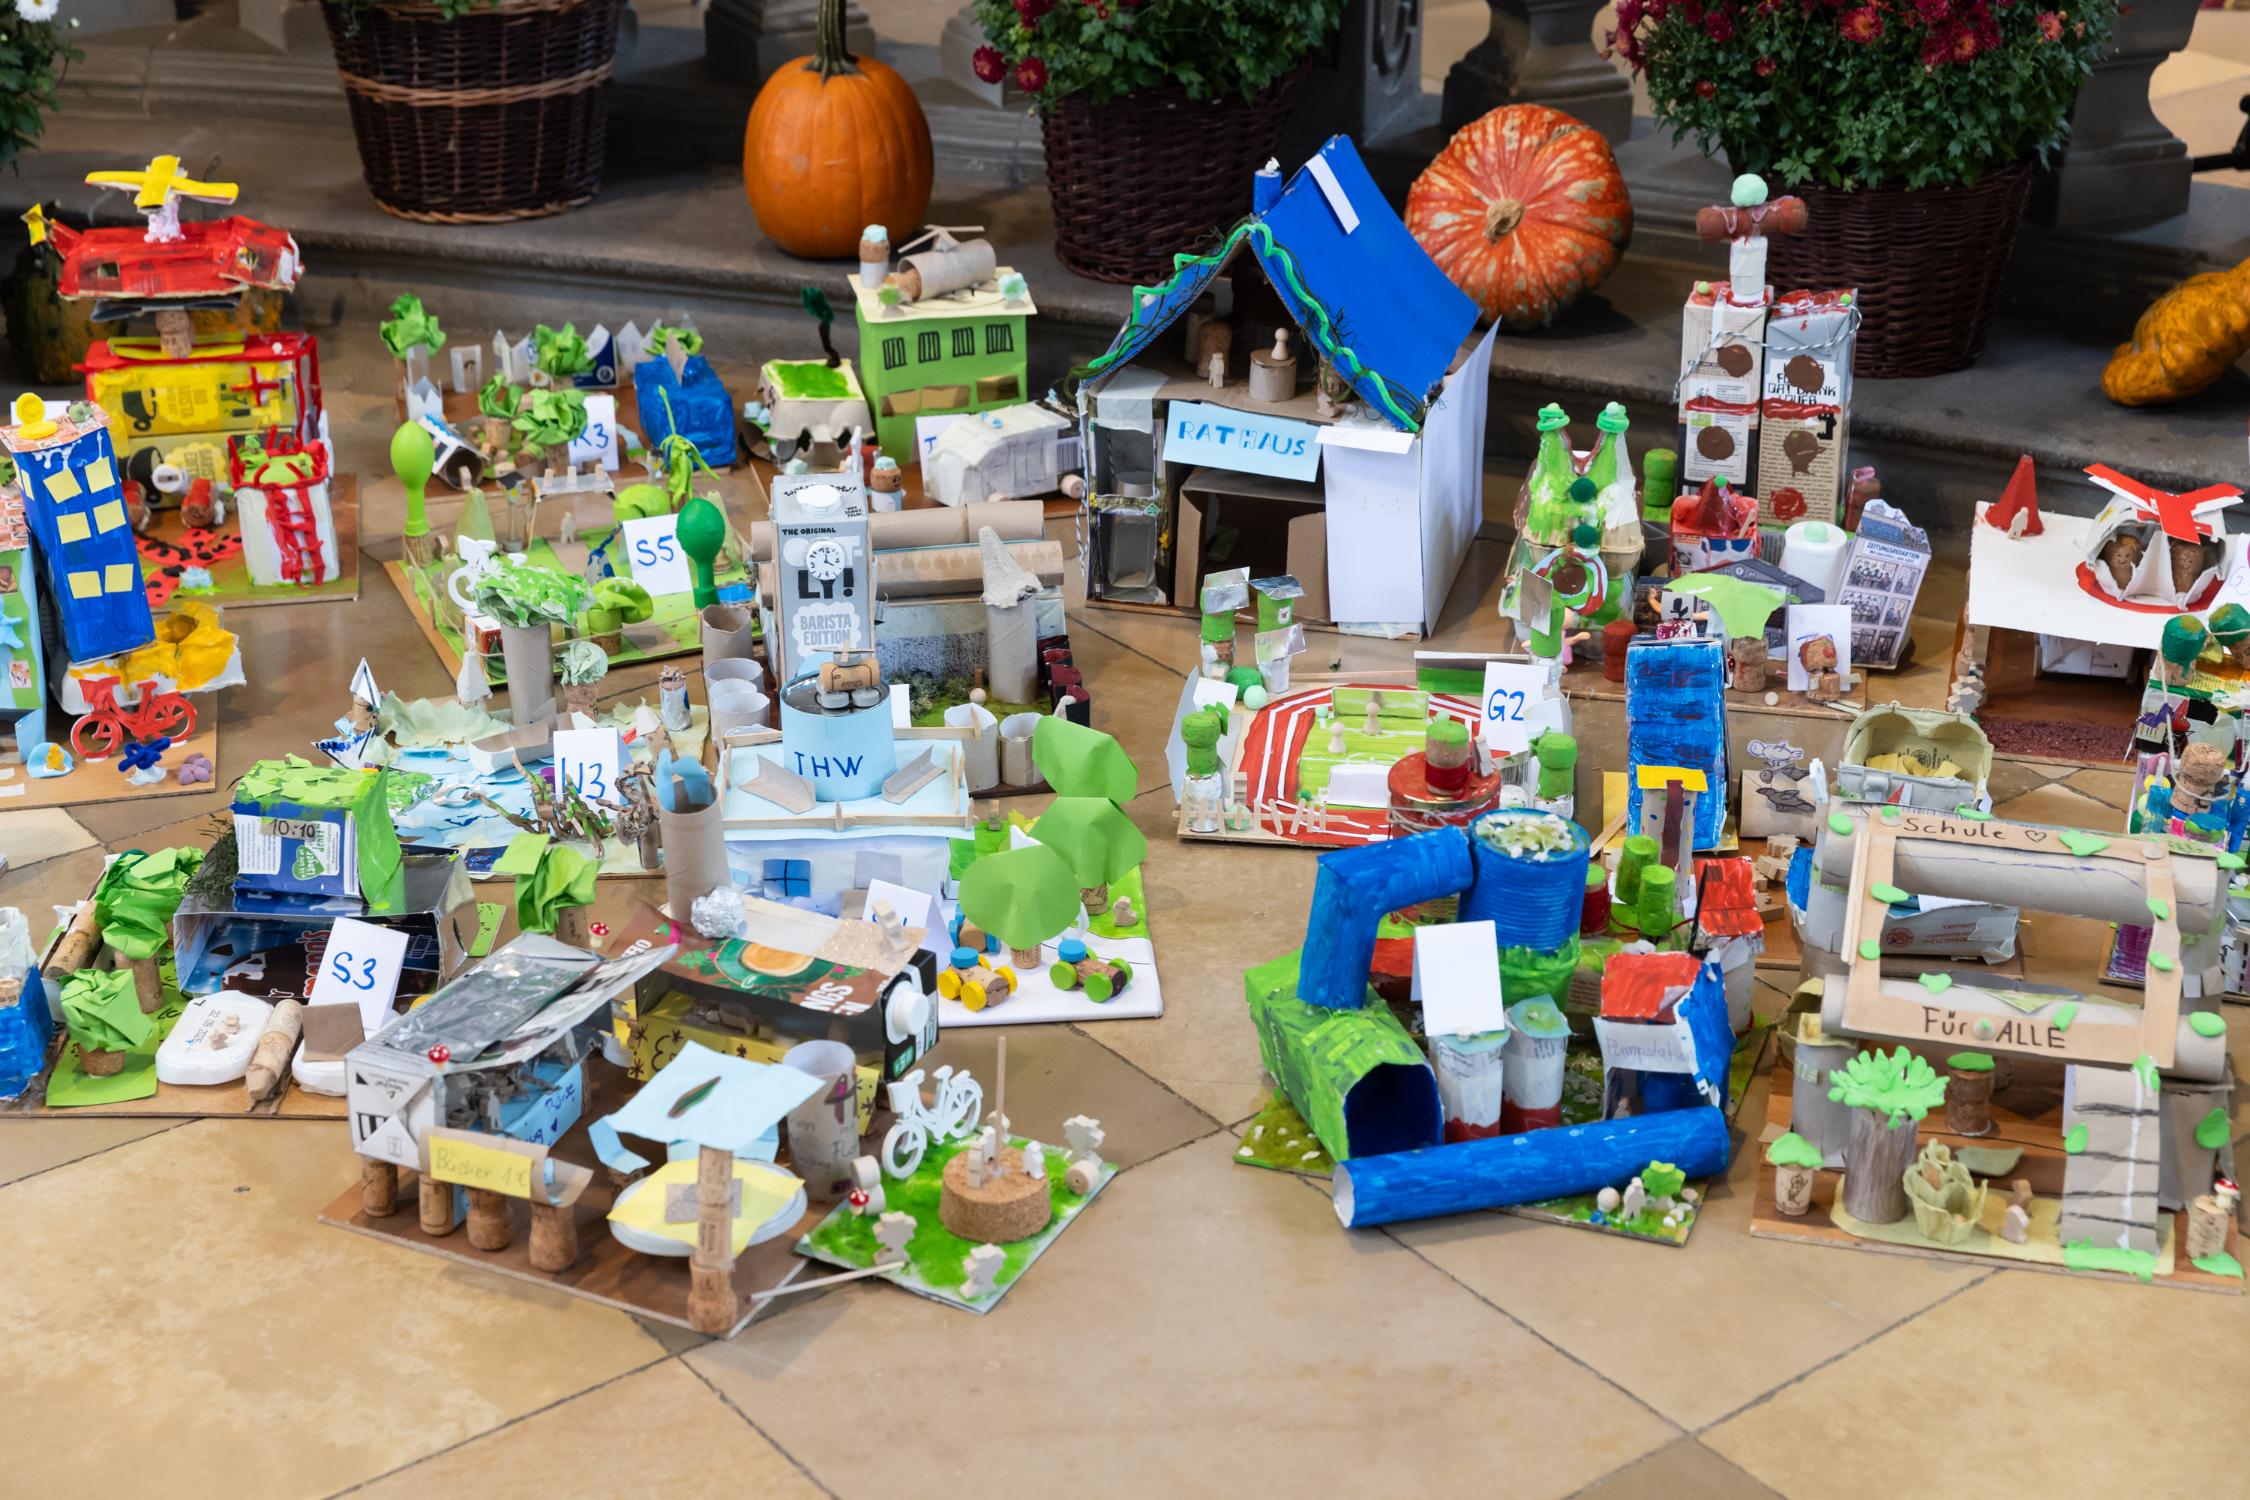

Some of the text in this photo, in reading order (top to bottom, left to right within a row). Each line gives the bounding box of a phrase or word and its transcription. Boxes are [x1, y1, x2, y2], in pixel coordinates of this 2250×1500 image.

[1178, 420, 1307, 457] RATHAUS
[781, 526, 837, 536] THE ORIGINAL
[636, 535, 675, 568] S5
[800, 613, 852, 631] BARISTA
[803, 629, 851, 646] EDITION
[1487, 688, 1526, 722] G2
[793, 751, 864, 778] THW
[269, 818, 317, 839] 10:10
[1903, 817, 2007, 840] Schule
[331, 951, 378, 991] S3
[1922, 1005, 2067, 1050] Für ALLE
